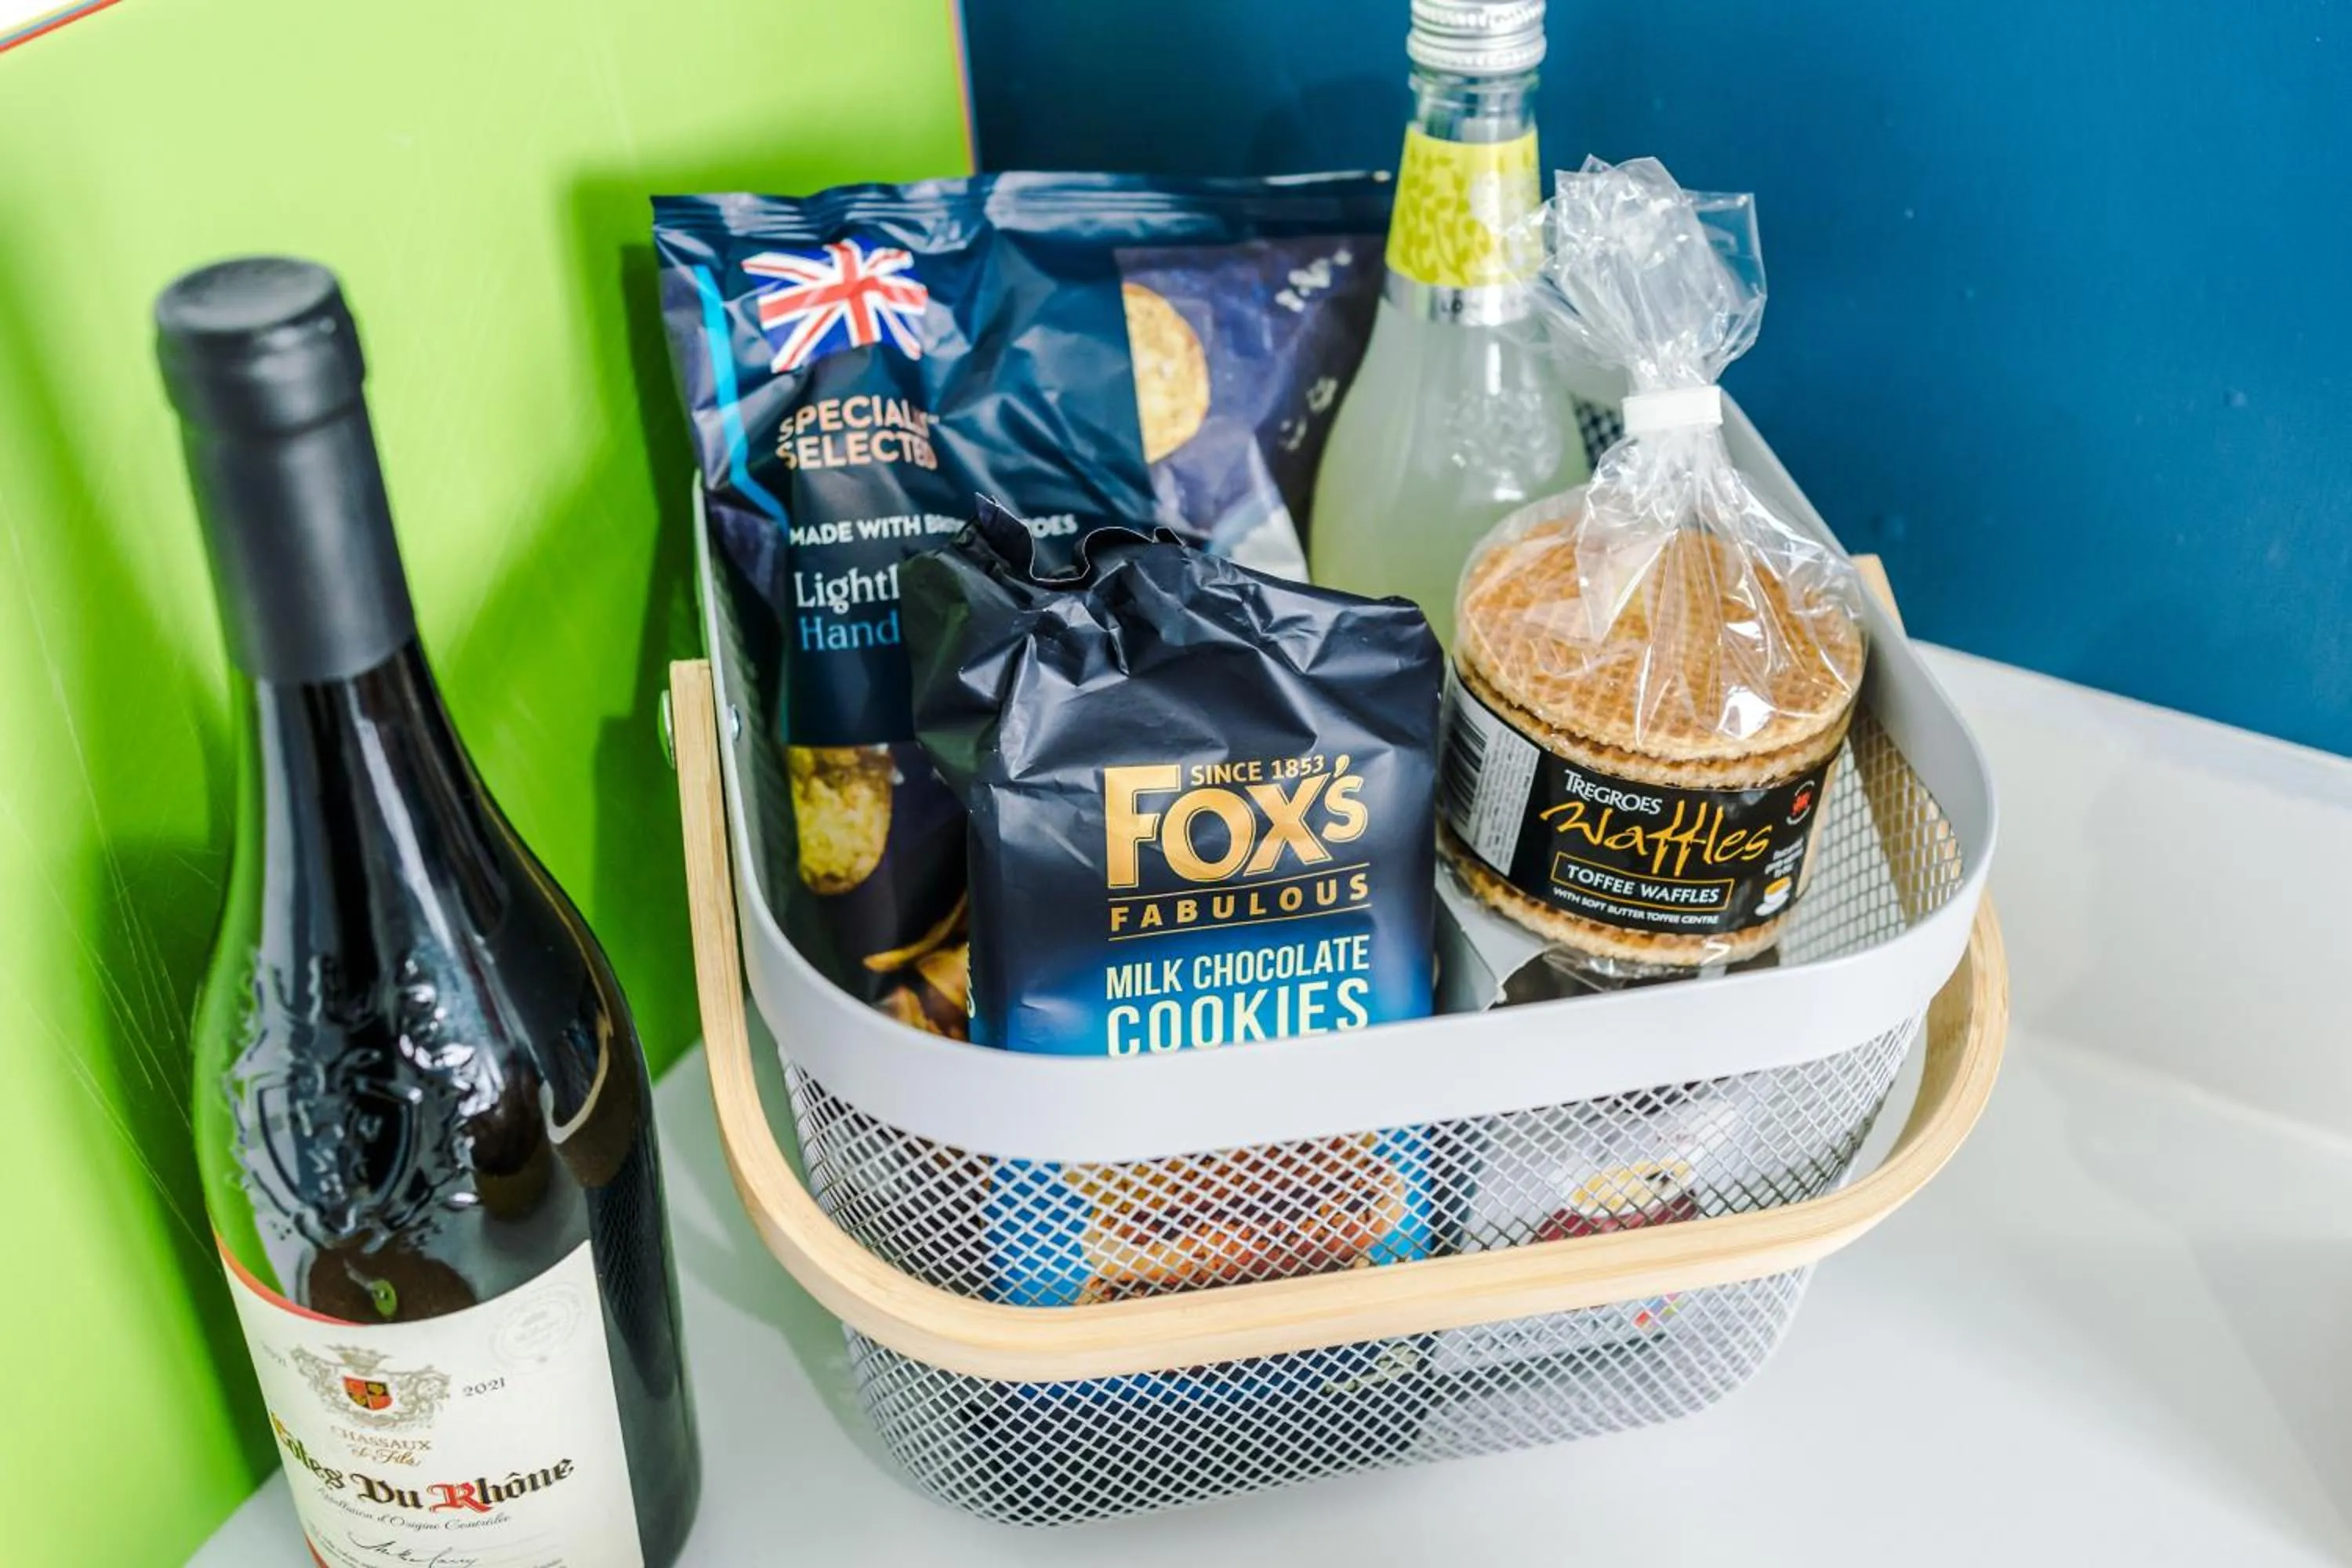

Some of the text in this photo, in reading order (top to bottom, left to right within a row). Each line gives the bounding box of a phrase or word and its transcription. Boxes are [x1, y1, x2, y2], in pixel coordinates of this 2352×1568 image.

[777, 394, 939, 444] SPECIAL
[789, 521, 854, 546] MADE
[856, 514, 922, 540] WITH
[793, 563, 901, 615] Lightl
[799, 609, 901, 651] Hand
[1190, 755, 1324, 786] SINCE 1853
[1564, 768, 1663, 815] TREGROES
[1539, 800, 1772, 877] Waffles
[1110, 872, 1370, 931] FABULOUS
[1567, 864, 1721, 905] TOFFEE WAFFLES
[1607, 905, 1646, 920] BUTTER
[1105, 934, 1370, 1000] MILK CHOCOLATE
[1107, 978, 1370, 1059] COOKIES
[462, 1376, 506, 1397] 2021
[349, 1472, 424, 1508] Du
[426, 1457, 575, 1513] Rhône
